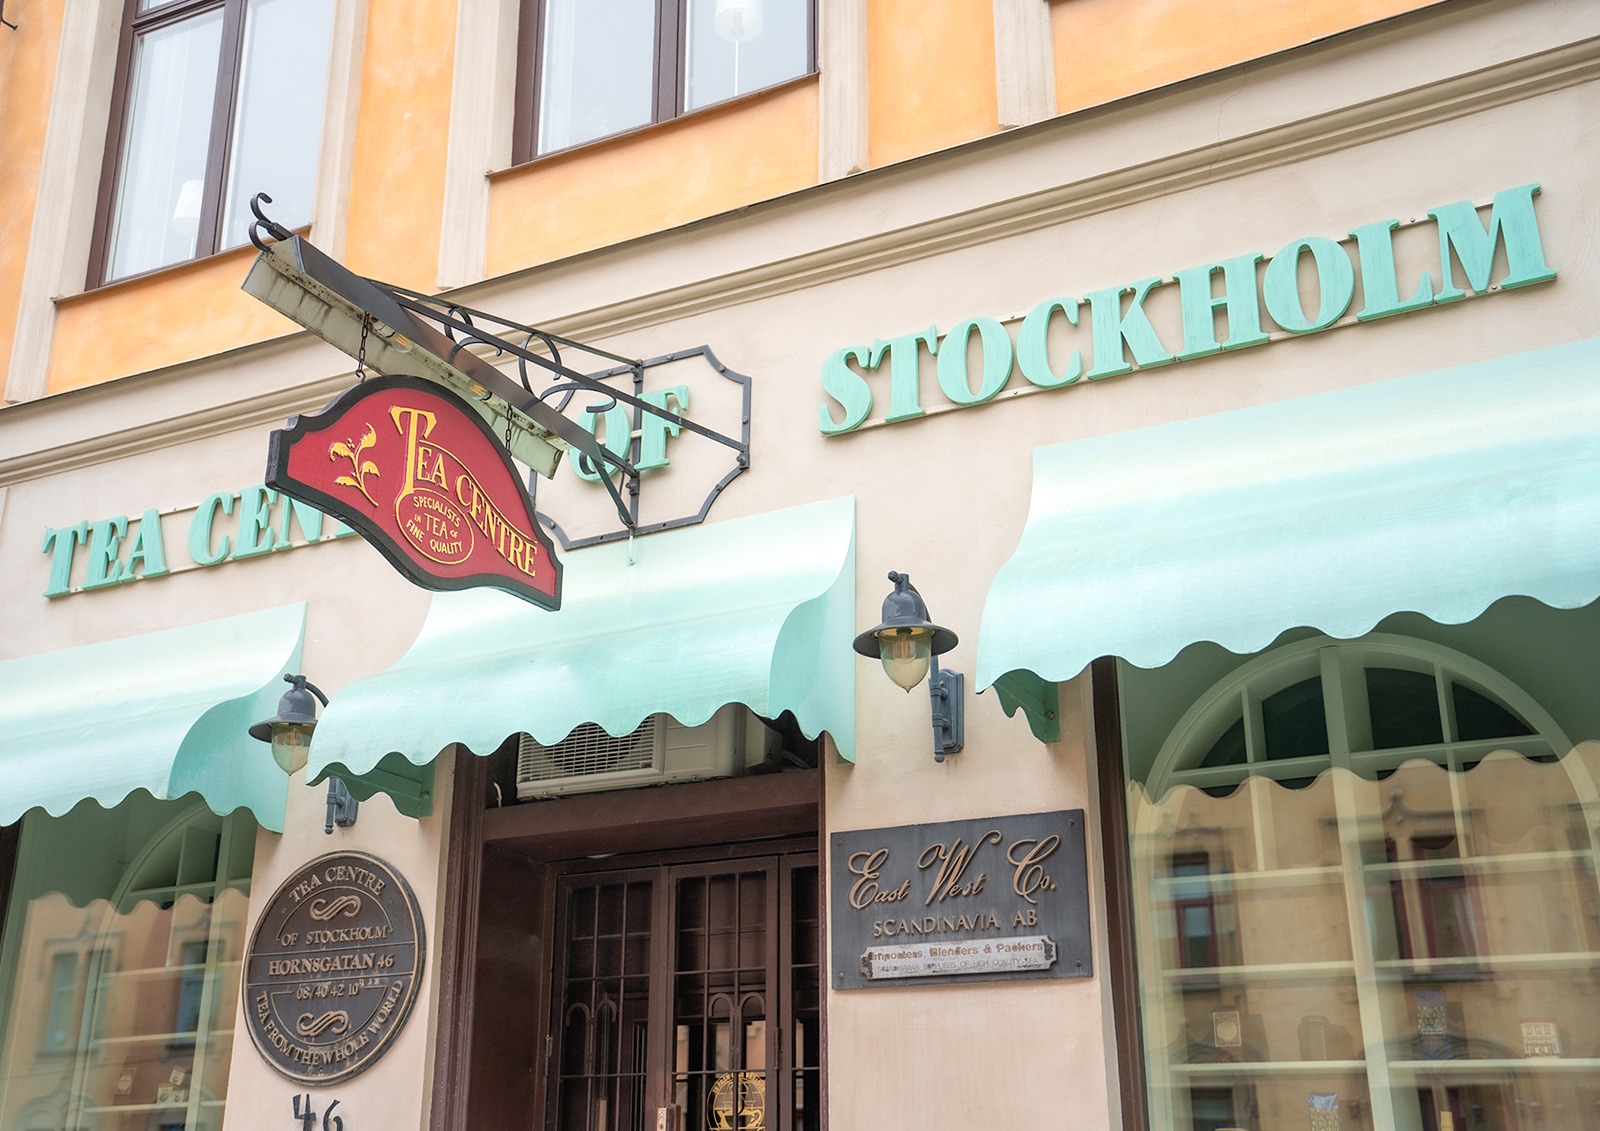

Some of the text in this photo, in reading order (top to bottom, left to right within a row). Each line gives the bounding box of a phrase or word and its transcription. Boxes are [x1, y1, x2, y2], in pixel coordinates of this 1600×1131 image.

[42, 183, 1557, 598] TEA CEN OF STOCKHOLM
[389, 405, 538, 578] TEA CENTRE
[413, 496, 461, 528] SPECIALISTS
[414, 513, 458, 540] IN TEA OF
[406, 519, 462, 555] FINE QUALITY
[289, 866, 386, 902] TEA CENTRE
[848, 829, 1060, 910] East West Co.
[281, 925, 388, 947] OF STOCKHOLM
[874, 909, 1038, 938] SCANDINAVIA AB
[268, 953, 395, 976] HORNSGATAN 46
[930, 945, 978, 957] Blenders
[983, 943, 992, 954] &
[996, 941, 1043, 953] Packers
[296, 982, 360, 1000] 08/40 42 10
[256, 980, 403, 1065] TEA FROM THE WHOLE WORLD
[292, 1093, 343, 1131] 46
